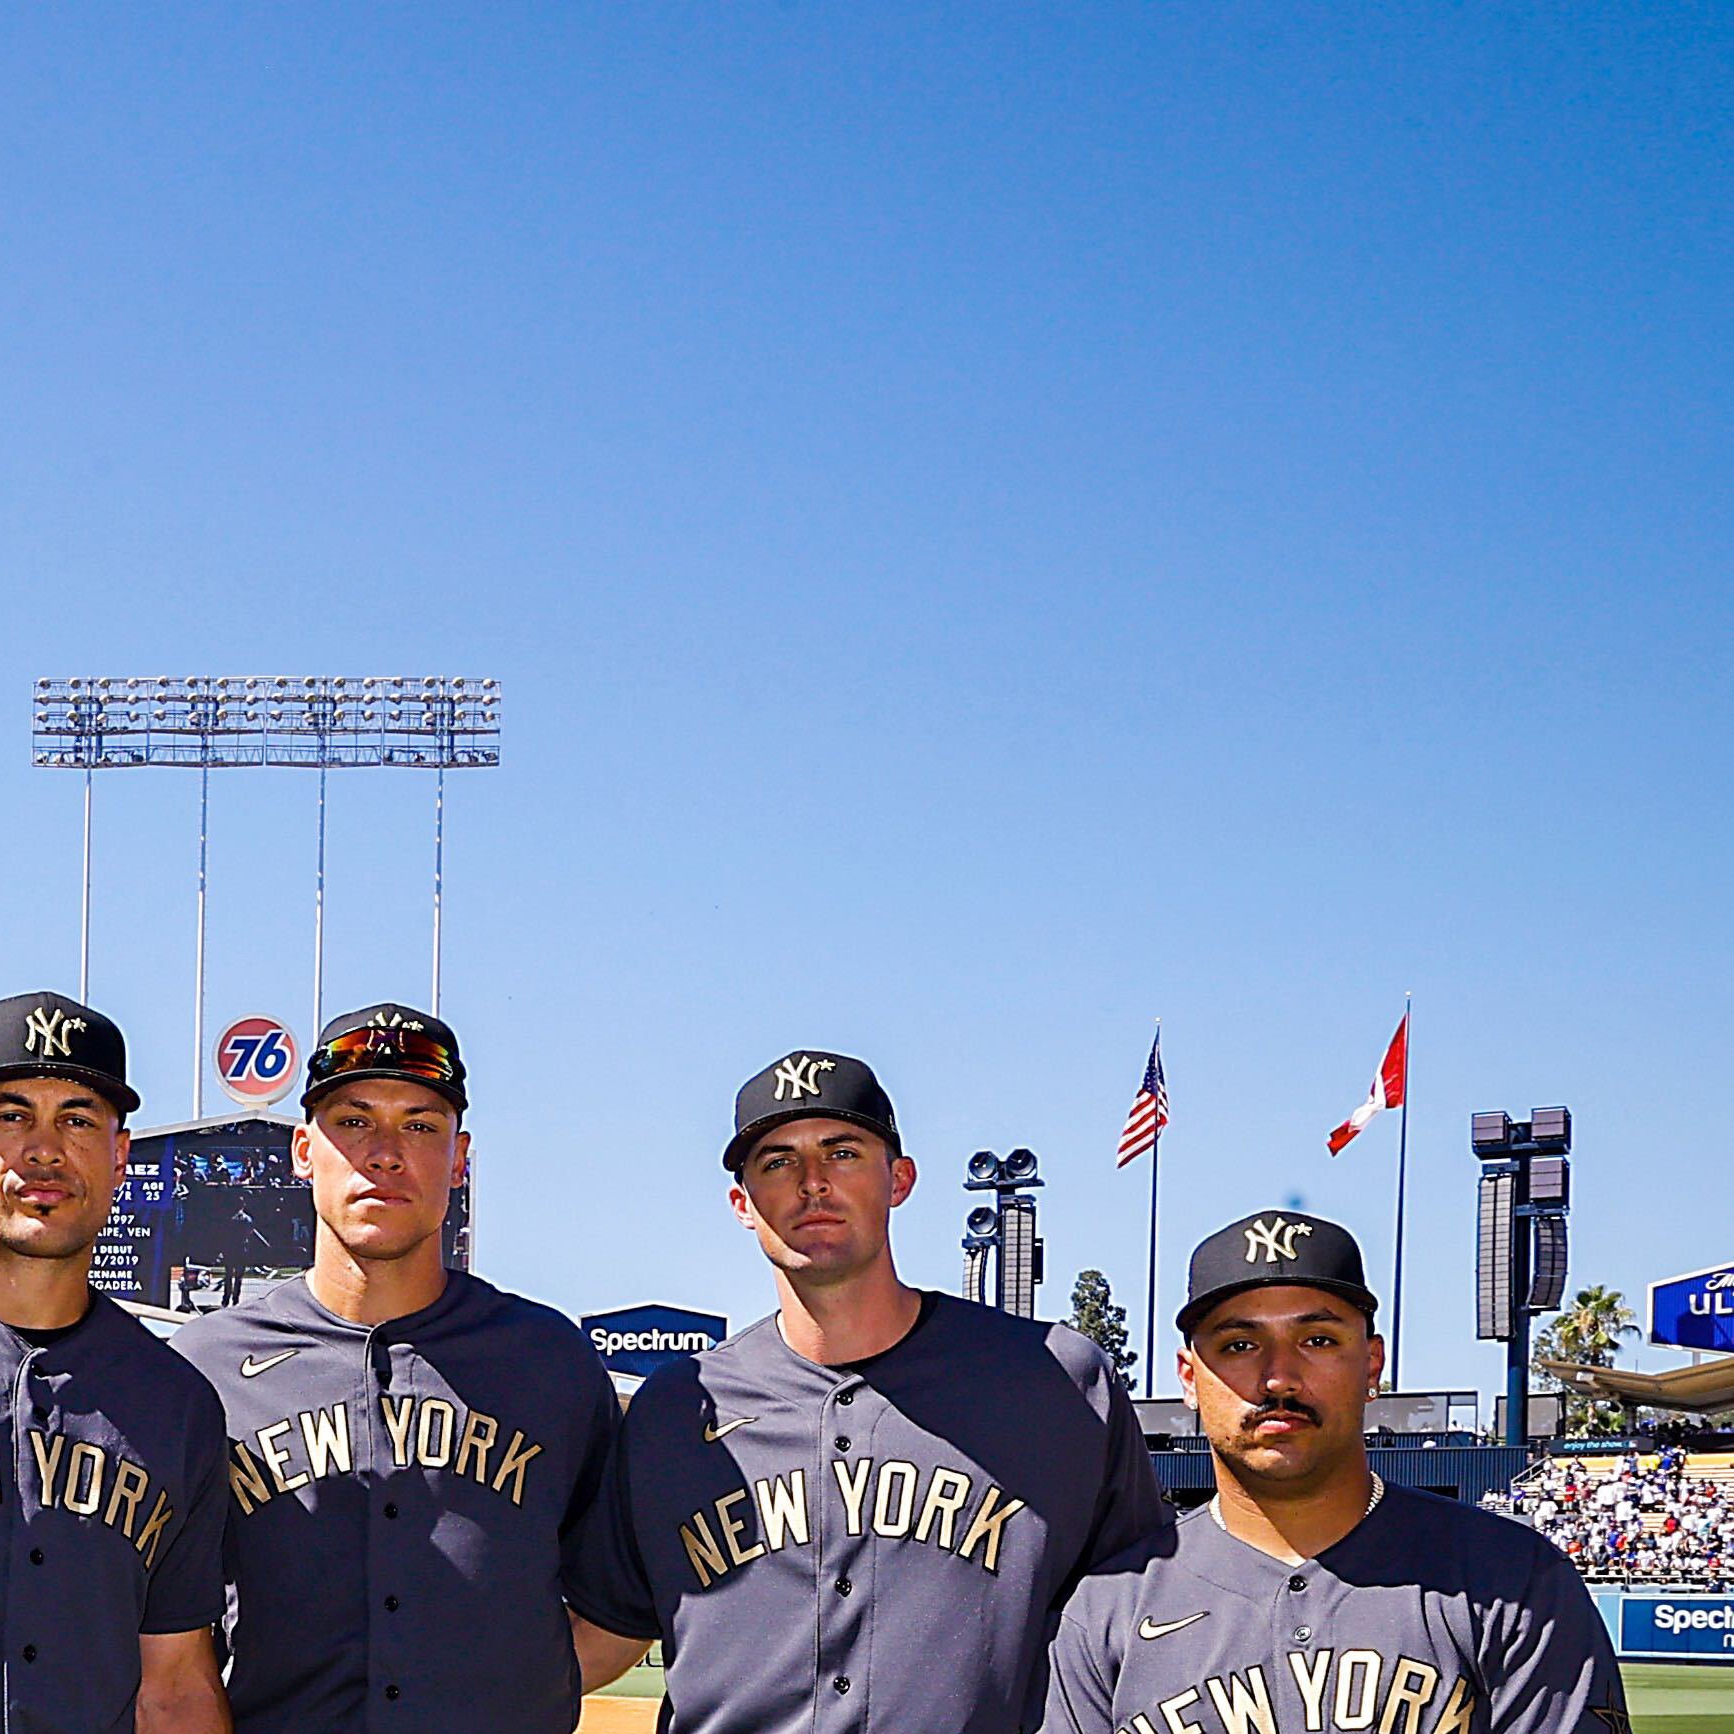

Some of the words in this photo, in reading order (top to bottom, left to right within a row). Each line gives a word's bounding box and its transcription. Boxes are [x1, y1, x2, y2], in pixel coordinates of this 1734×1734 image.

[24, 1006, 73, 1057] NY
[224, 1029, 288, 1082] 76
[773, 1055, 820, 1101] NY
[145, 1191, 160, 1201] 25
[107, 1214, 135, 1225] 1997
[126, 1227, 151, 1237] VEN
[99, 1245, 133, 1254] DEBUT
[1243, 1216, 1299, 1264] NY
[1688, 1292, 1734, 1316] UL
[590, 1328, 709, 1357] Spectrum
[228, 1400, 353, 1517] NEW
[379, 1395, 543, 1508] YORK
[29, 1429, 174, 1571] YORK
[678, 1468, 811, 1590] NEW
[832, 1457, 1028, 1574] YORK
[1654, 1604, 1734, 1635] Spect
